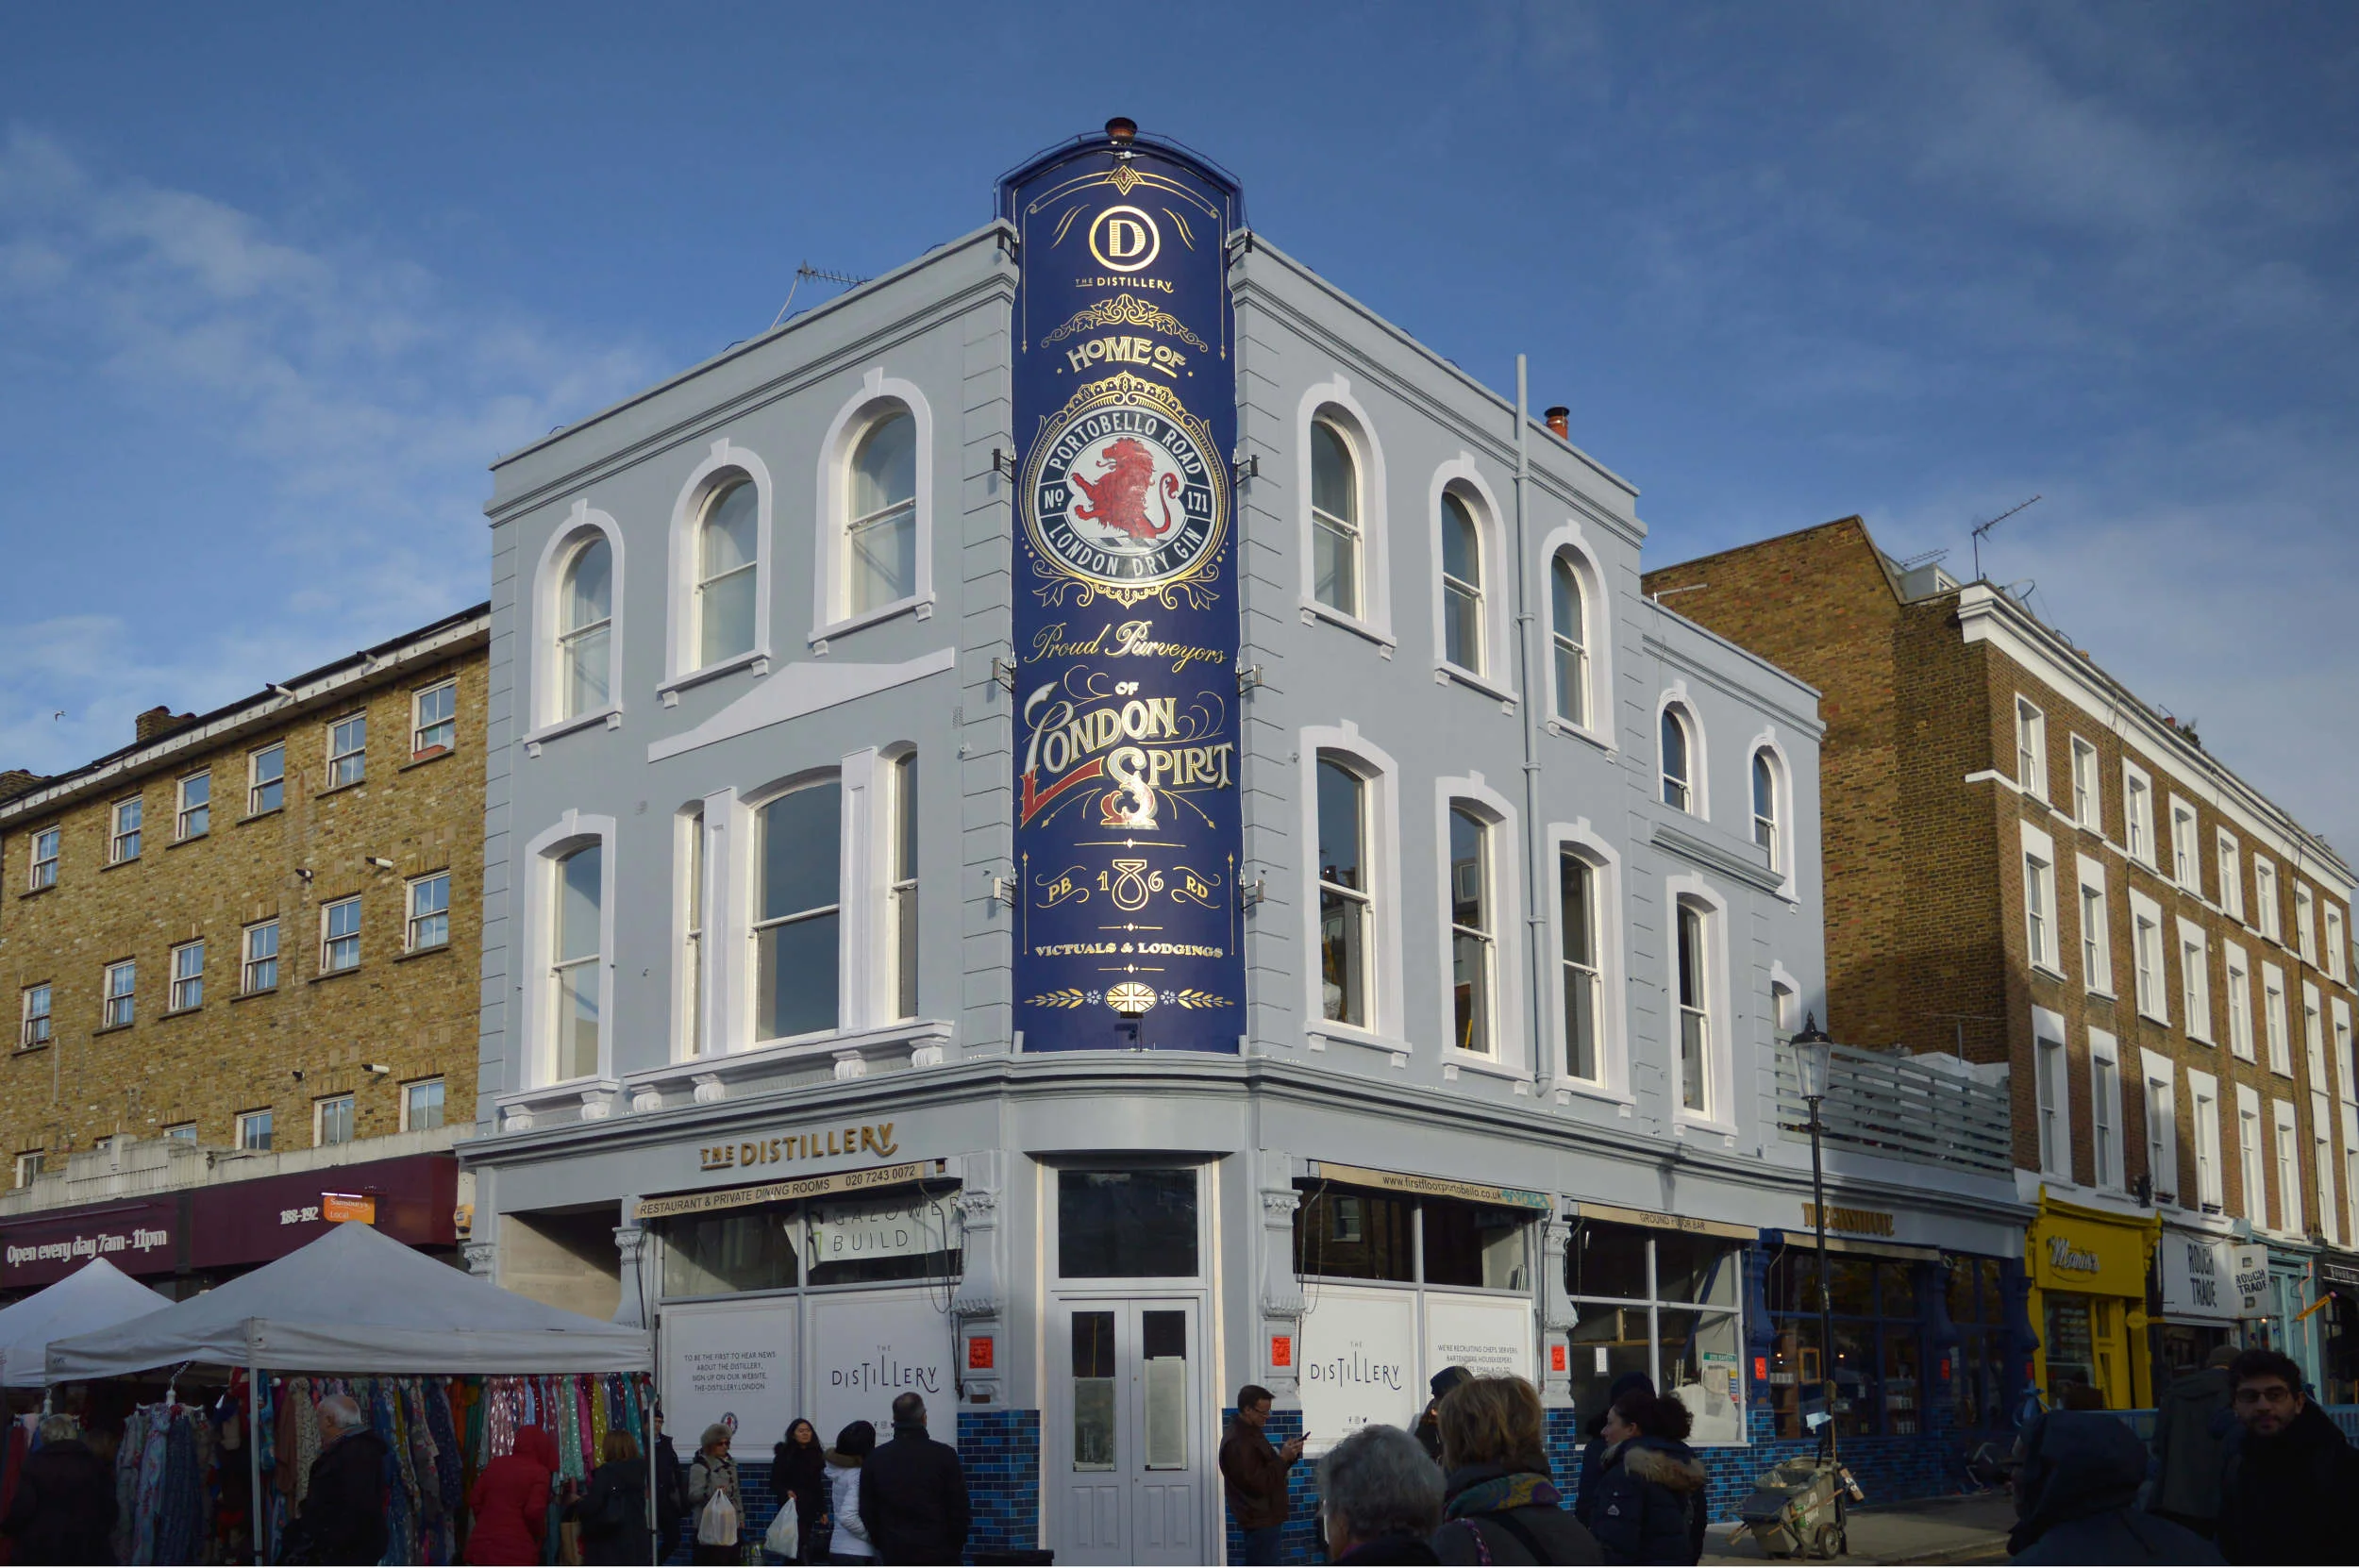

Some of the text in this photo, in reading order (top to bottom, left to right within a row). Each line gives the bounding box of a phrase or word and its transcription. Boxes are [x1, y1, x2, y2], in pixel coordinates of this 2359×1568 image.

[1109, 220, 1146, 257] D
[1076, 277, 1174, 293] THE DISTILLERY
[1065, 336, 1187, 373] HOME OF
[1048, 412, 1202, 475] PORTOBELLO ROAD
[1188, 491, 1209, 512] 171
[1048, 524, 1203, 577] LONDON DRY GIN
[1024, 620, 1227, 673] Proud Purveyors
[1114, 681, 1139, 696] OF
[1020, 681, 1180, 829] LONDON
[1100, 742, 1233, 830] SPIRIT
[1048, 876, 1072, 902] PB
[1185, 875, 1209, 899] RD
[1035, 942, 1224, 959] VICTUALS & LODGINGS
[699, 1123, 899, 1167] THE DISTILLERY
[639, 1164, 915, 1216] RESTAURANT & PRIVATE DINING ROOMS 020 7243 0072
[1382, 1176, 1502, 1201] www.firstfloorportobello.co.uk
[280, 1207, 319, 1225] 188-192
[8, 1243, 37, 1268] Open
[38, 1241, 71, 1262] every
[72, 1235, 96, 1260] day
[97, 1234, 125, 1254] 7am
[833, 1230, 909, 1252] BUILD
[2187, 1243, 2215, 1276] ROUGH
[2234, 1269, 2267, 1285] ROUGH
[2236, 1279, 2268, 1295] TRADE
[2190, 1277, 2217, 1309] TRADE
[718, 1362, 728, 1371] THE
[741, 1351, 757, 1359] HEAR
[692, 1374, 706, 1382] SIGN
[715, 1373, 726, 1381] ON
[831, 1355, 940, 1393] DISTILLERY
[1310, 1351, 1401, 1391] DISTILLERY
